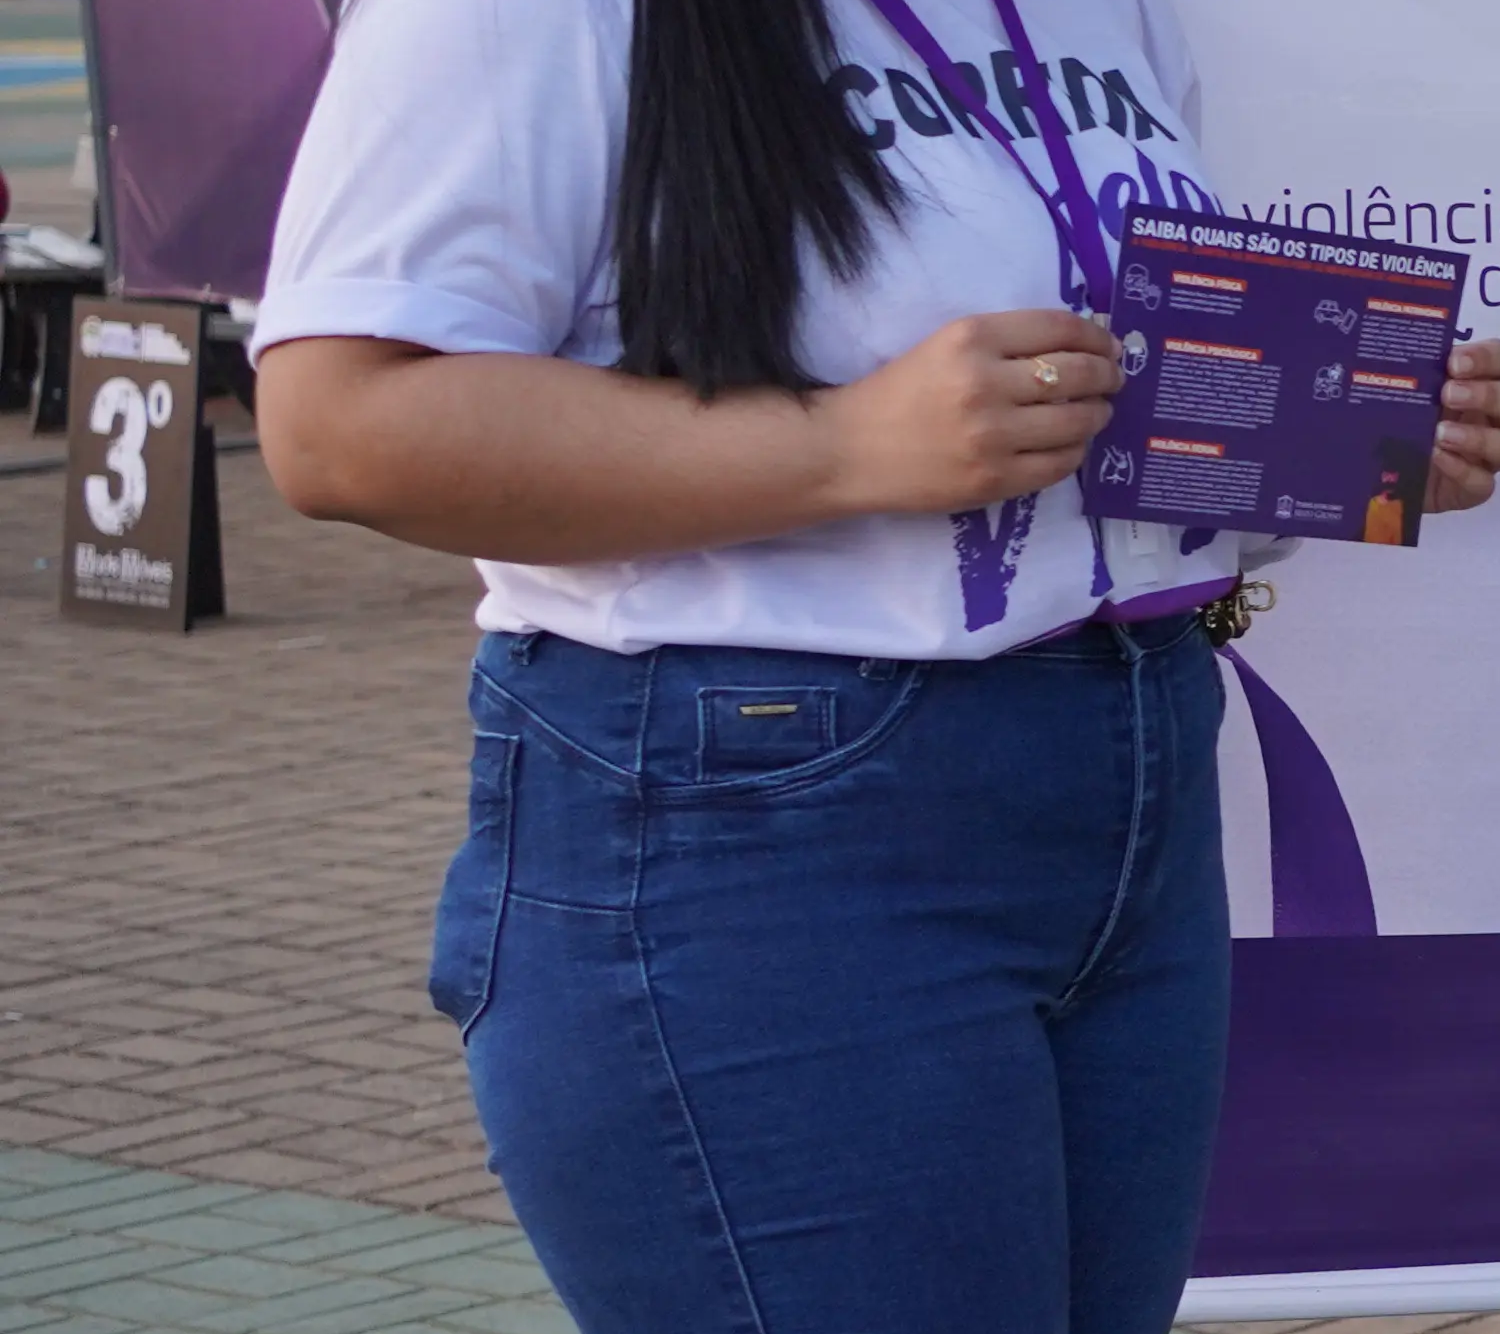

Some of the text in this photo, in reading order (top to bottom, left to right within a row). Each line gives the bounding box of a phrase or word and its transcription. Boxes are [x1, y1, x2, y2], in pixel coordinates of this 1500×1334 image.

[1132, 217, 1188, 242] SAIBA
[1190, 226, 1245, 251] QUAIS
[1246, 232, 1281, 255] SÃO
[1283, 239, 1307, 259] OS
[1309, 243, 1357, 267] TIPOS
[1359, 251, 1380, 270] DE
[1381, 255, 1456, 281] VIOLÊNCIA
